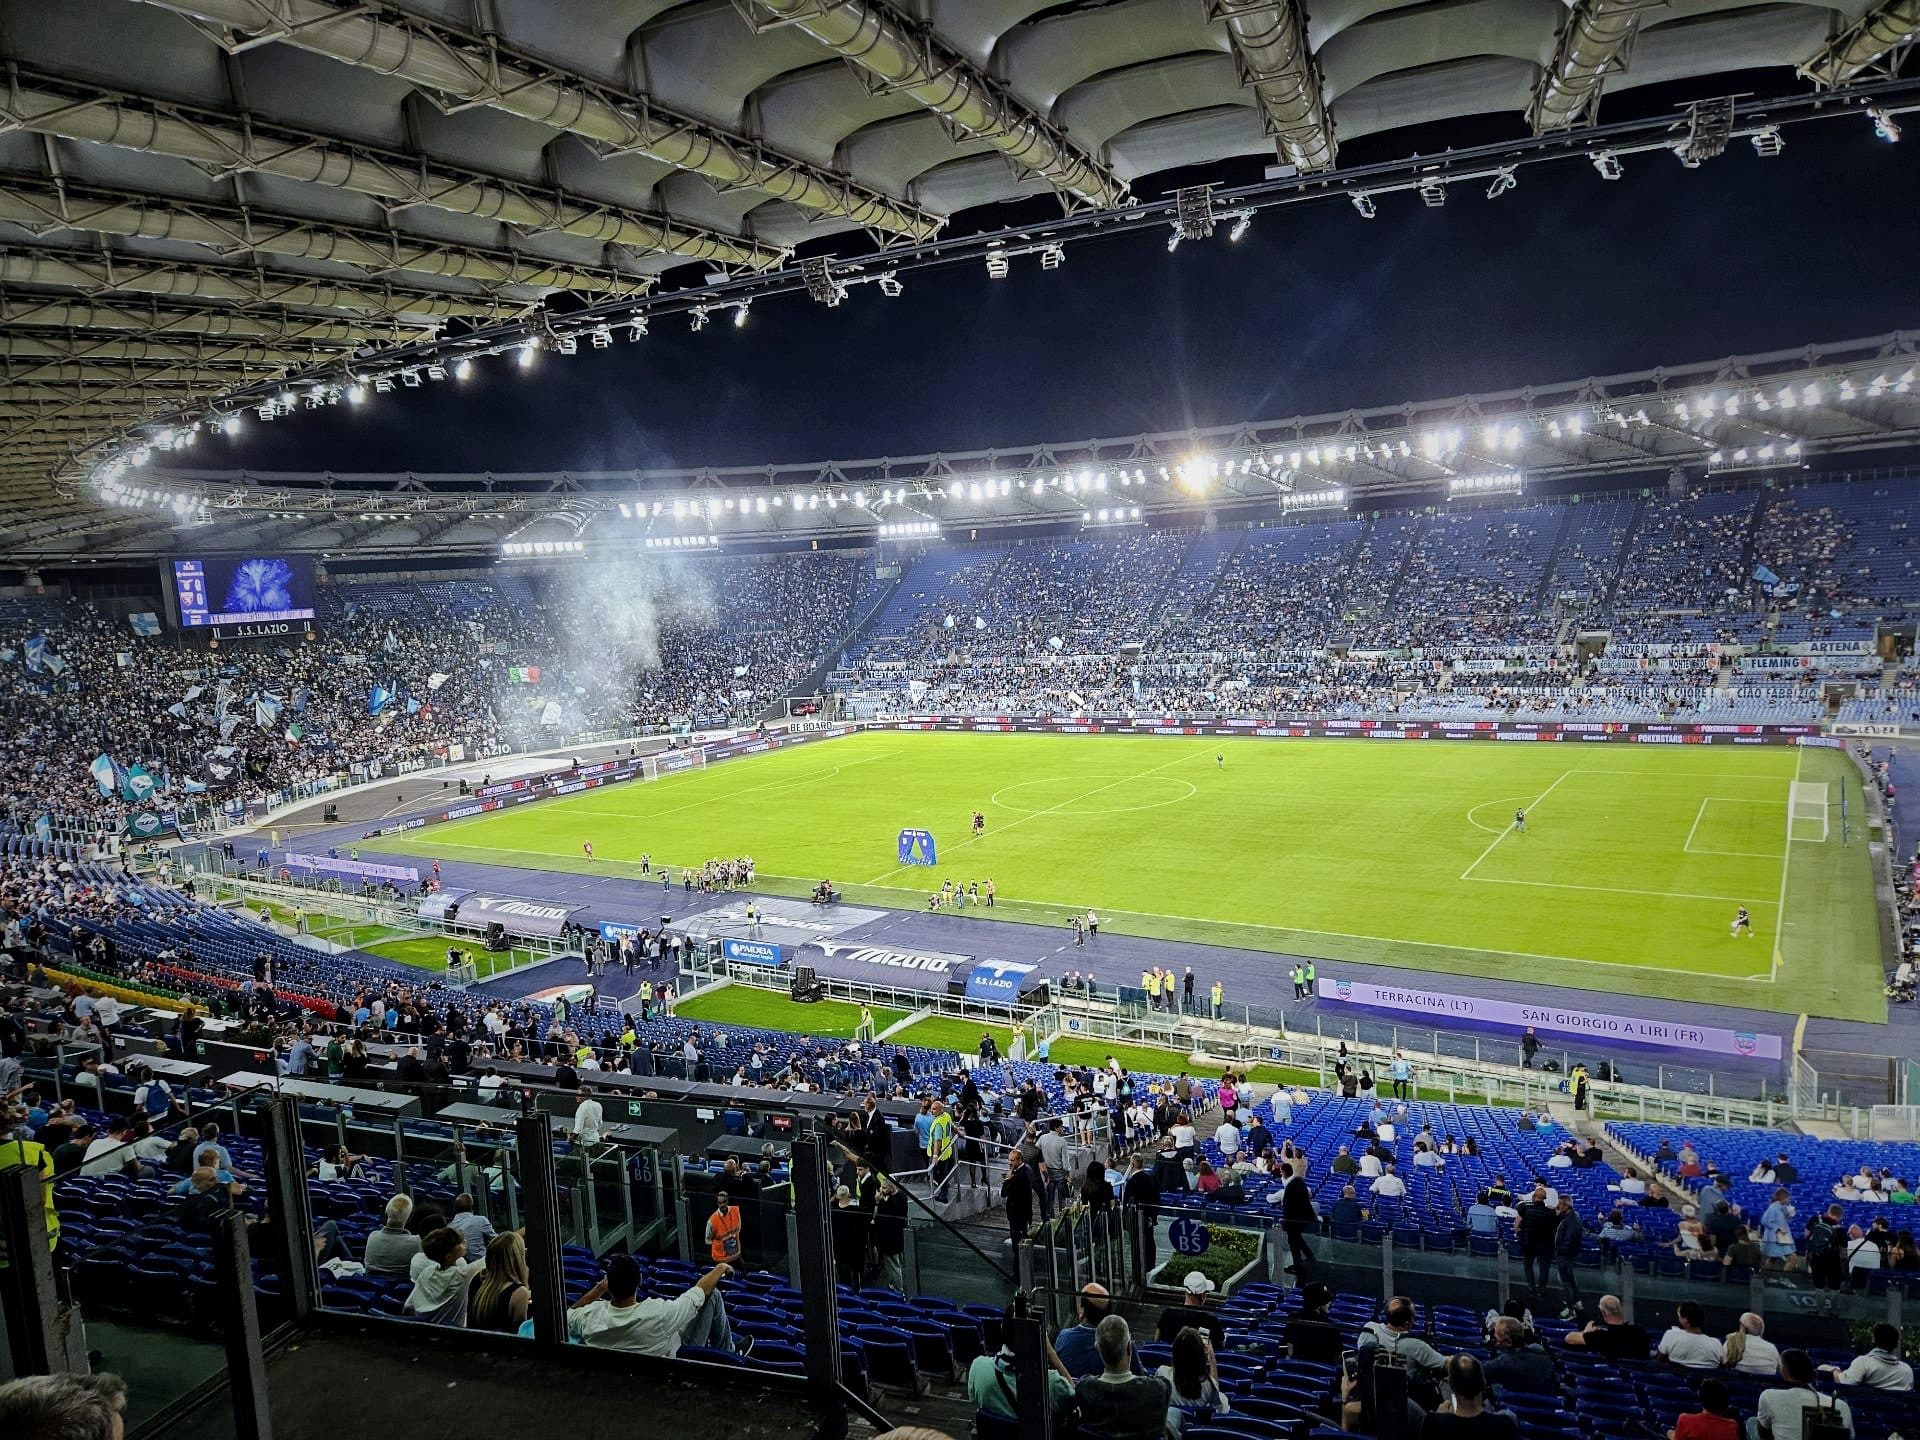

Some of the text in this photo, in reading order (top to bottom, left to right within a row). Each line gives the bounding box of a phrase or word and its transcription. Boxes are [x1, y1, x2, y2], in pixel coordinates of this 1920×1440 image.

[237, 623, 289, 636] S.S. LAZIO
[1810, 642, 1861, 651] ARTENA
[1751, 658, 1800, 668] FLEMING
[1511, 687, 1546, 697] LAIALE
[1653, 687, 1670, 698] NL
[1674, 687, 1707, 698] CUORE
[1737, 688, 1816, 698] CIAO FABRIZIO
[740, 944, 773, 955] PAIDEIA
[975, 976, 1012, 989] S.S. LAZIO
[1375, 990, 1704, 1044] TERRACINA (LT) SAN GIORGIO A LIRI (FR)
[634, 1169, 651, 1183] BD
[1178, 1220, 1200, 1237] 12
[1179, 1235, 1202, 1253] BS
